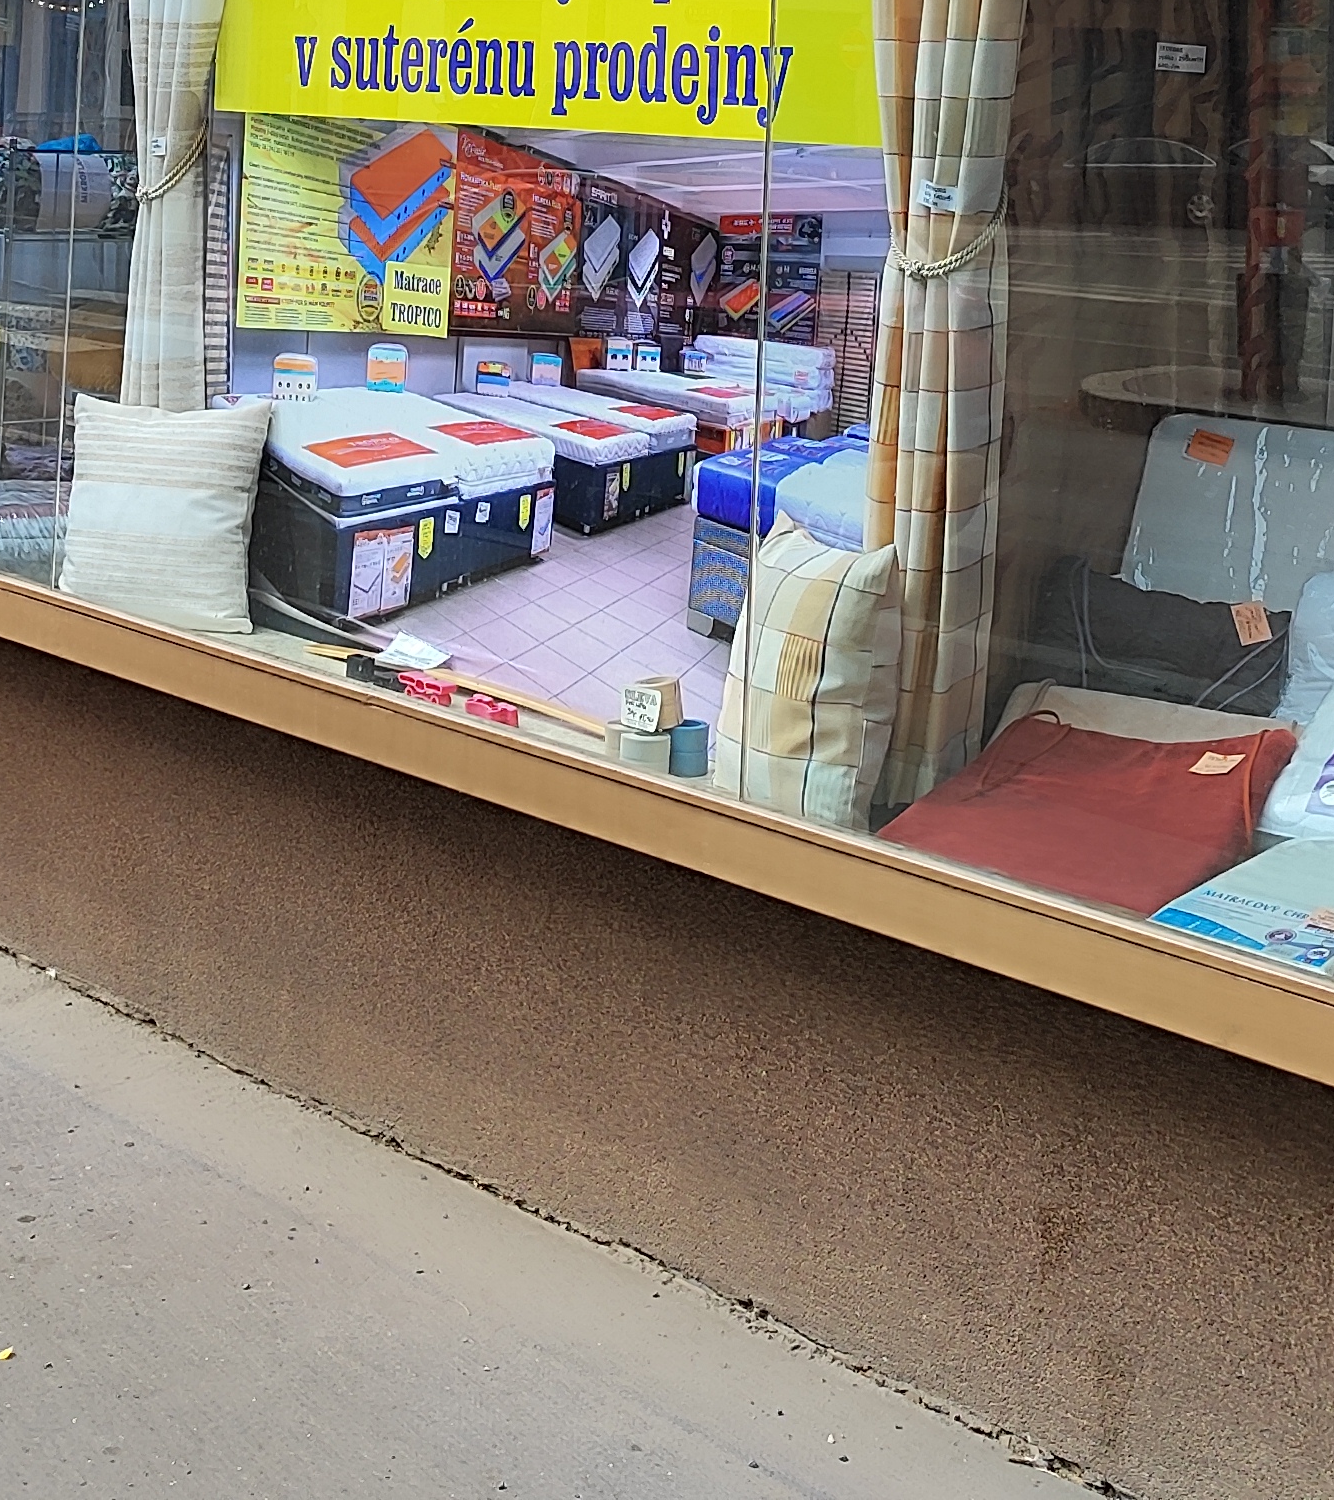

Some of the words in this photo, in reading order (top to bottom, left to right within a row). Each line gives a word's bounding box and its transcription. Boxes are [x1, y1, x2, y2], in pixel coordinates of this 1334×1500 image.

[294, 34, 318, 88] v
[330, 17, 537, 98] suterénu
[551, 25, 794, 126] prodejny
[393, 269, 442, 296] Matrace
[390, 301, 442, 329] TROPICO
[1202, 889, 1281, 913] MATRACOVÝ
